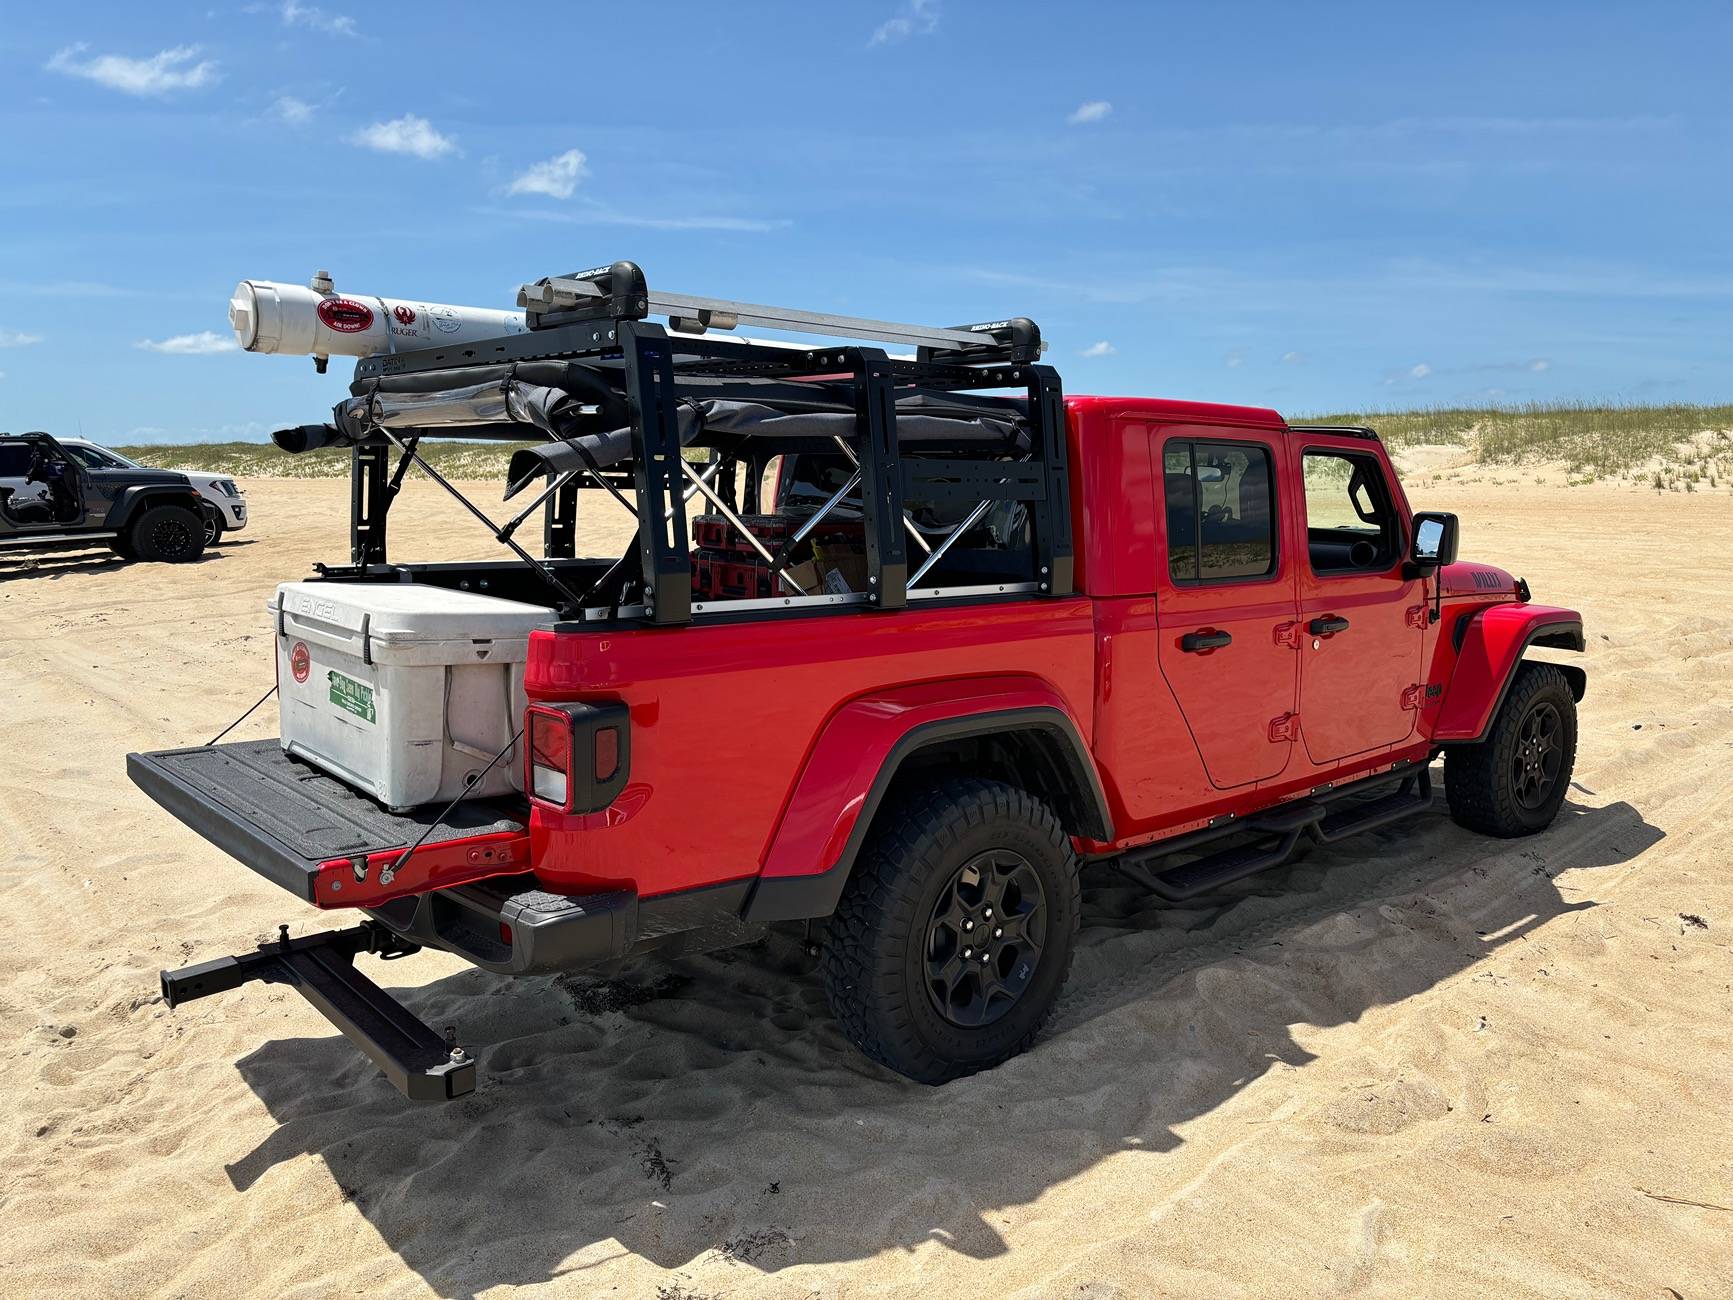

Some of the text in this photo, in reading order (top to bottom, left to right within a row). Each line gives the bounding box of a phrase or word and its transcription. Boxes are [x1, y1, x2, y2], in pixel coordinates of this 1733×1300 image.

[349, 301, 368, 313] CLOWN
[391, 327, 417, 337] RUGER
[301, 599, 341, 621] ENGEL
